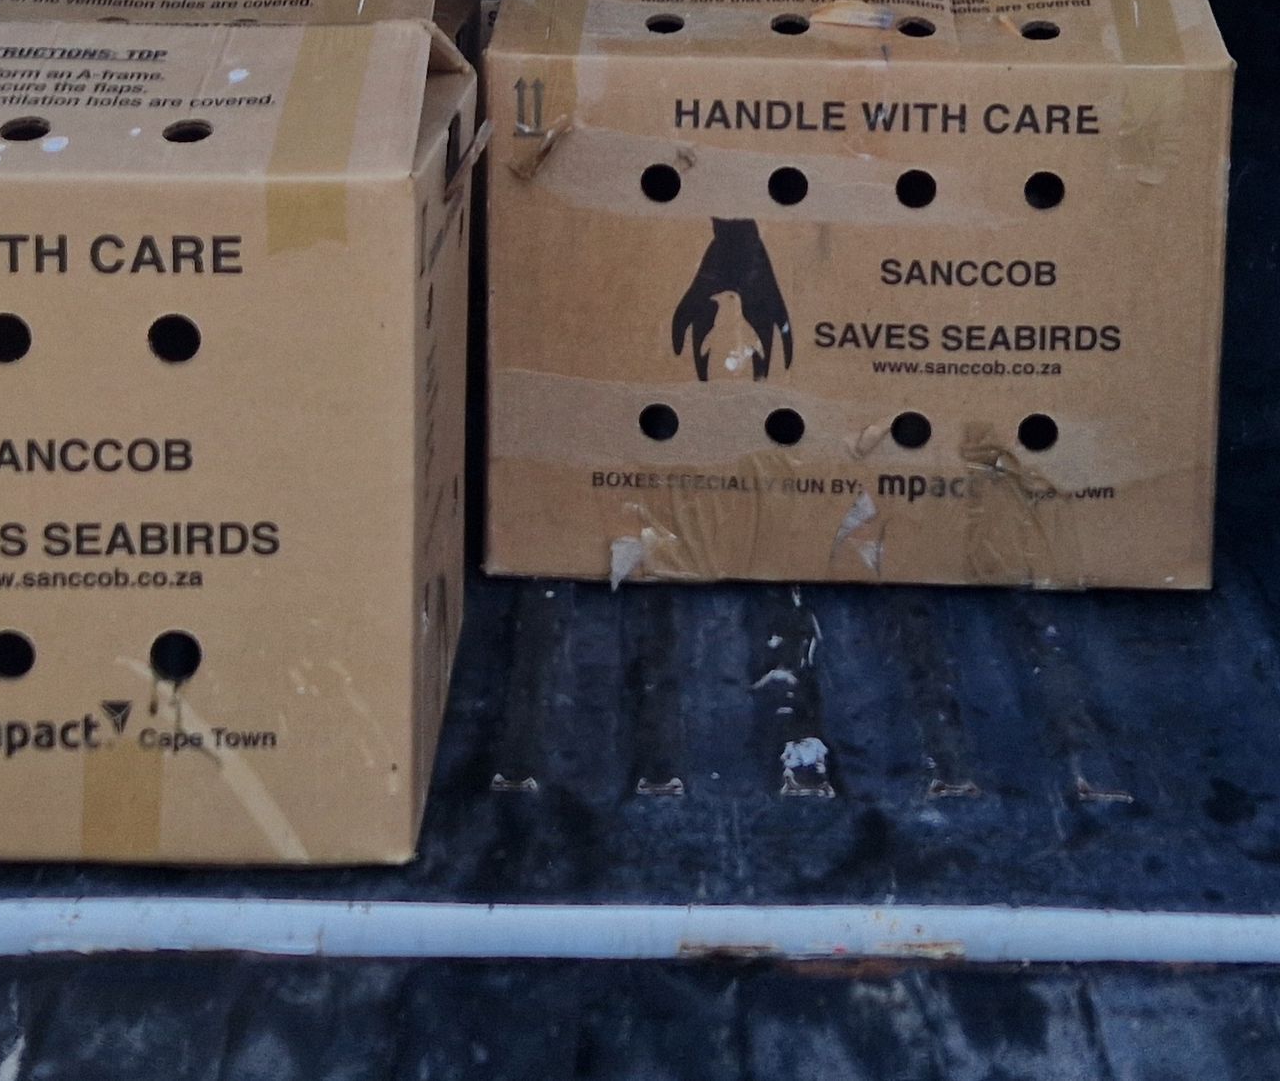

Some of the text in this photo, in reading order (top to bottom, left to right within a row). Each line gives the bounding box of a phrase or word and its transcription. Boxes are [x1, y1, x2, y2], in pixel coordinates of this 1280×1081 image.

[210, 0, 238, 9] are
[996, 2, 1021, 13] are
[126, 49, 169, 62] TOP
[46, 70, 71, 80] an
[54, 82, 86, 93] the
[85, 95, 142, 107] holes
[149, 97, 183, 107] are
[188, 94, 275, 107] covered.
[675, 99, 1100, 134] HANDLE WITH CARE
[89, 234, 243, 274] CARE
[880, 258, 1057, 287] SANCCOB
[814, 321, 1121, 352] SAVES SEABIRDS
[872, 359, 1062, 376] www.sanccob.co.za
[592, 471, 660, 489] BOXES
[782, 478, 825, 494] RUN
[42, 521, 280, 557] SEABIRDS
[139, 726, 277, 753] Cape Town
